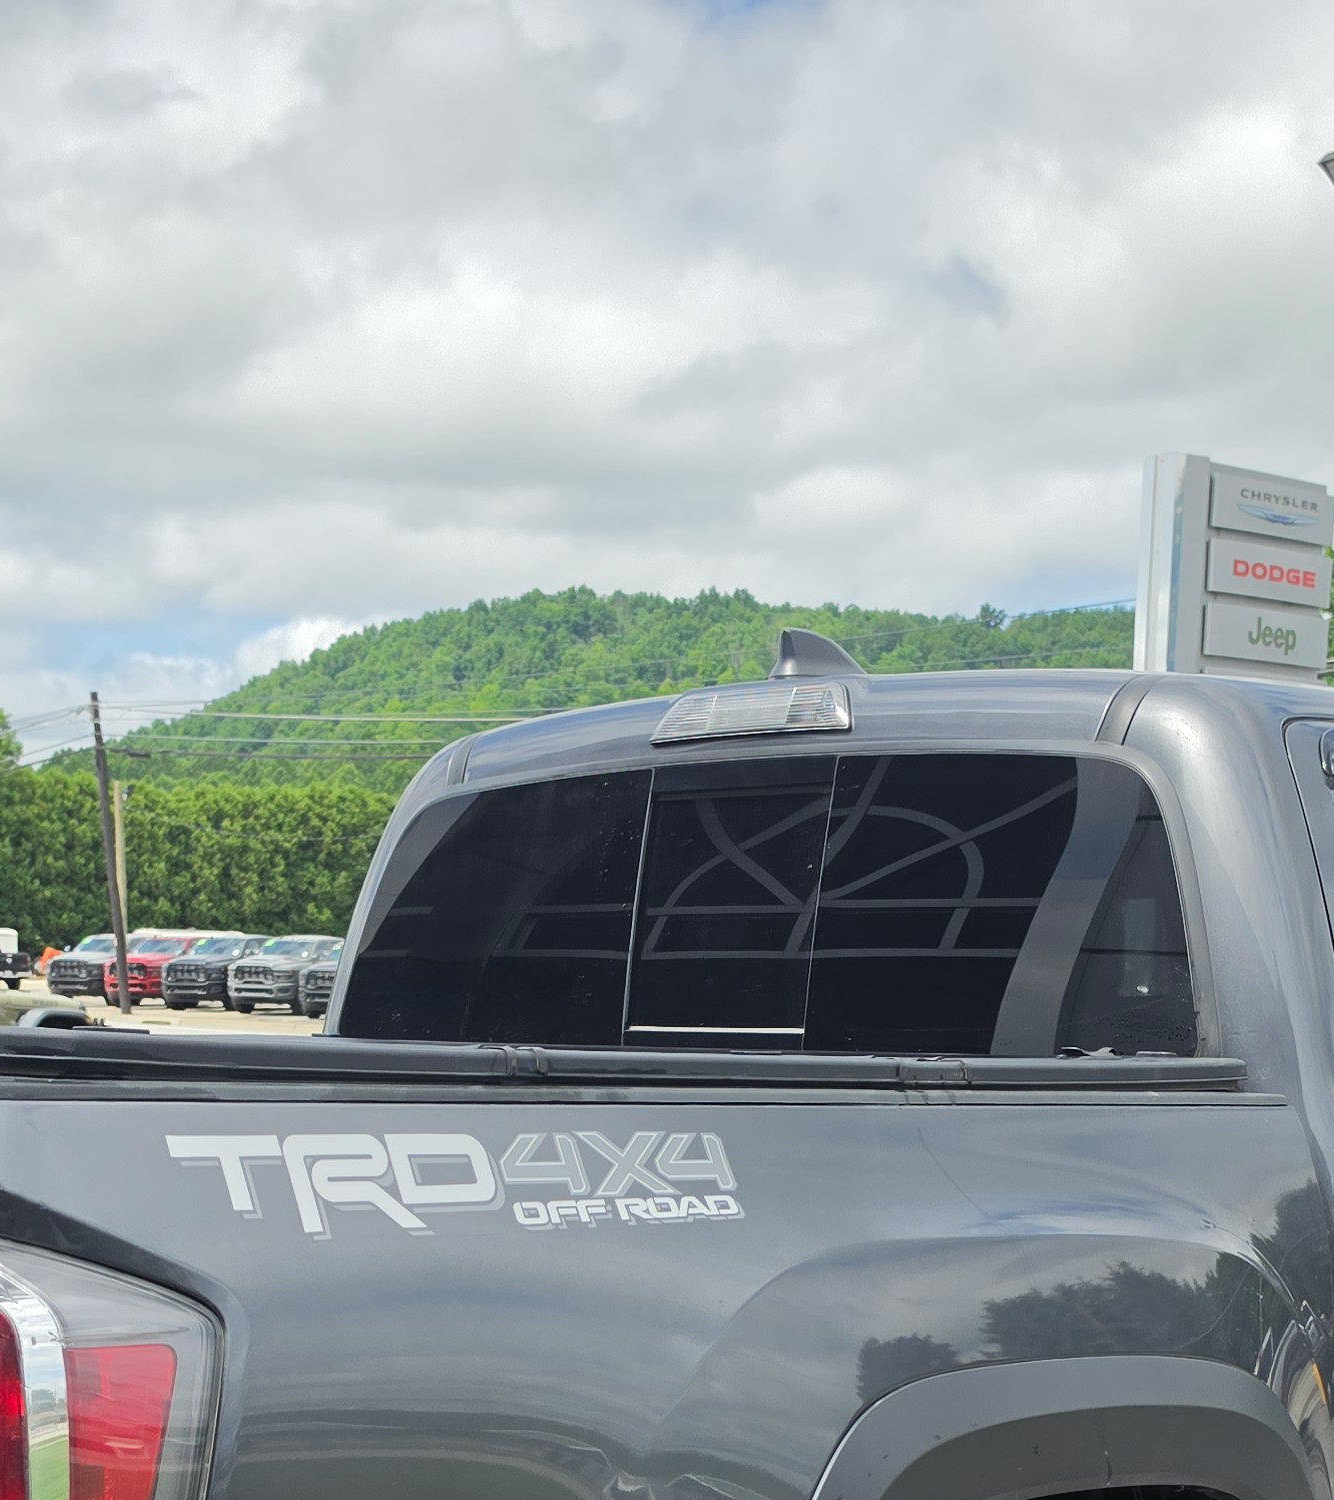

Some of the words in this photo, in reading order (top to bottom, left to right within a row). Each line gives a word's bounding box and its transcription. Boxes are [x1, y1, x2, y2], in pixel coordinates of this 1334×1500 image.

[1240, 488, 1319, 512] CHRYSLER
[1232, 559, 1317, 588] DODGE
[1247, 616, 1297, 655] Jeep
[165, 1133, 499, 1237] TRD
[513, 1198, 608, 1229] OFF
[618, 1194, 743, 1224] ROAD
